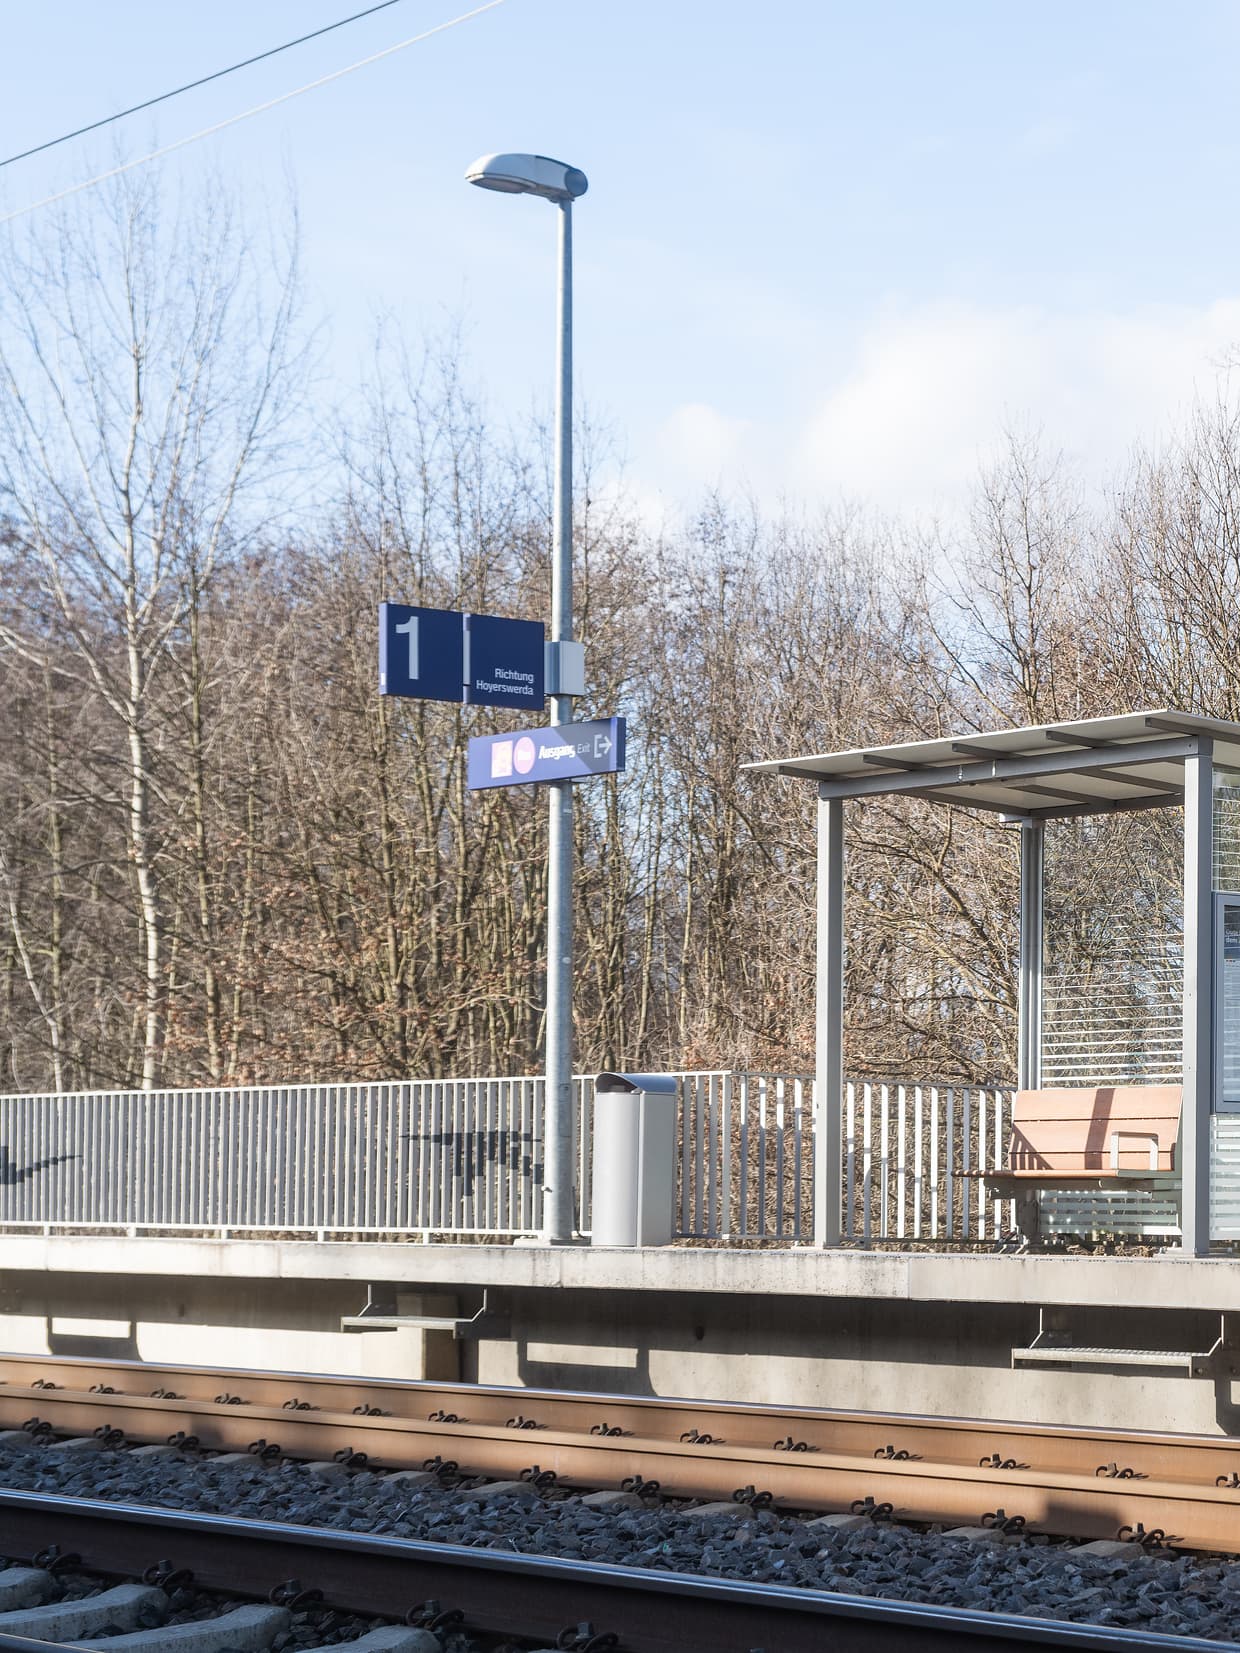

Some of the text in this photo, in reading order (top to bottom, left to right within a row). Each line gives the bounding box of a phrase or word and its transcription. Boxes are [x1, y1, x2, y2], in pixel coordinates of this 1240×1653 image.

[395, 616, 419, 680] 1
[494, 667, 534, 684] Richtung
[476, 680, 534, 695] Hoyerswerda
[538, 742, 591, 760] Ausgang Exit
